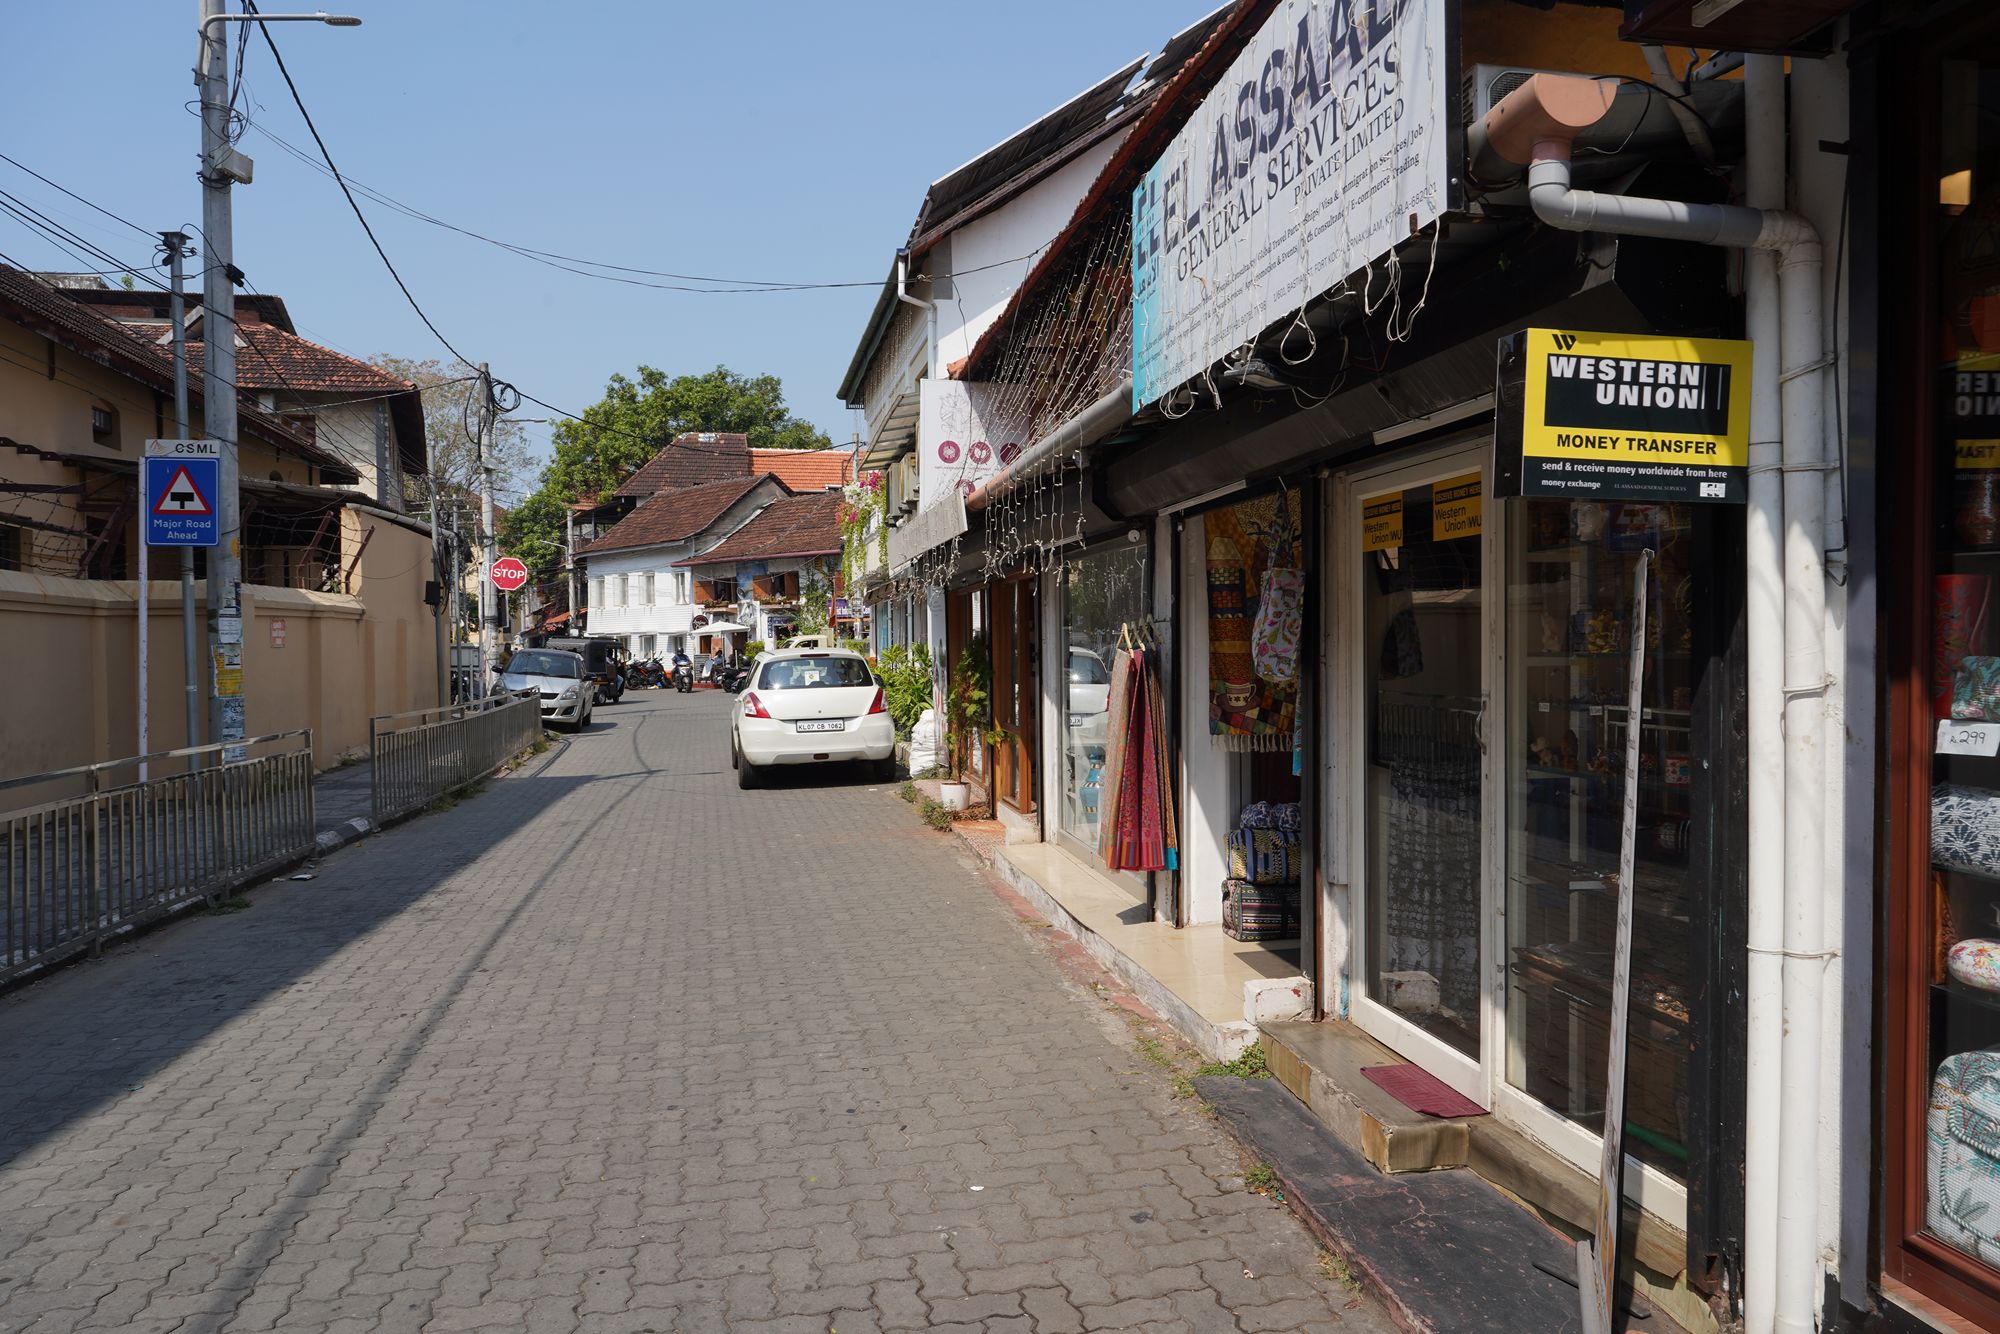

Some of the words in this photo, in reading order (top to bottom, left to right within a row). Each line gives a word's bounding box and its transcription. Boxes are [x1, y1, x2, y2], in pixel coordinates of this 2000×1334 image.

[1409, 122, 1423, 145] Job
[1293, 147, 1341, 206] PRIVATE
[1344, 95, 1404, 164] LIMITED
[1177, 175, 1262, 282] GENERAL
[1266, 36, 1399, 203] SERVICES
[1163, 157, 1199, 254] EL
[1549, 355, 1700, 386] WESTERN
[1596, 383, 1699, 410] UNION
[175, 443, 217, 454] CSML
[1556, 433, 1621, 450] MONEY
[1625, 437, 1717, 455] TRANSFER
[1542, 462, 1563, 470] send
[1565, 462, 1572, 471] &
[1574, 463, 1605, 473] receive
[1607, 465, 1636, 476] money
[1638, 466, 1684, 476] worldwide
[1686, 468, 1706, 477] from
[1708, 469, 1728, 478] here
[1541, 479, 1566, 489] money
[1567, 480, 1601, 490] exchange
[1435, 505, 1466, 521] Western
[153, 519, 182, 530] Major
[186, 519, 211, 528] Road
[1364, 520, 1389, 535] Western
[1444, 517, 1466, 533] Union
[167, 530, 198, 540] Ahead
[1371, 532, 1388, 545] Union
[493, 568, 525, 579] STOP
